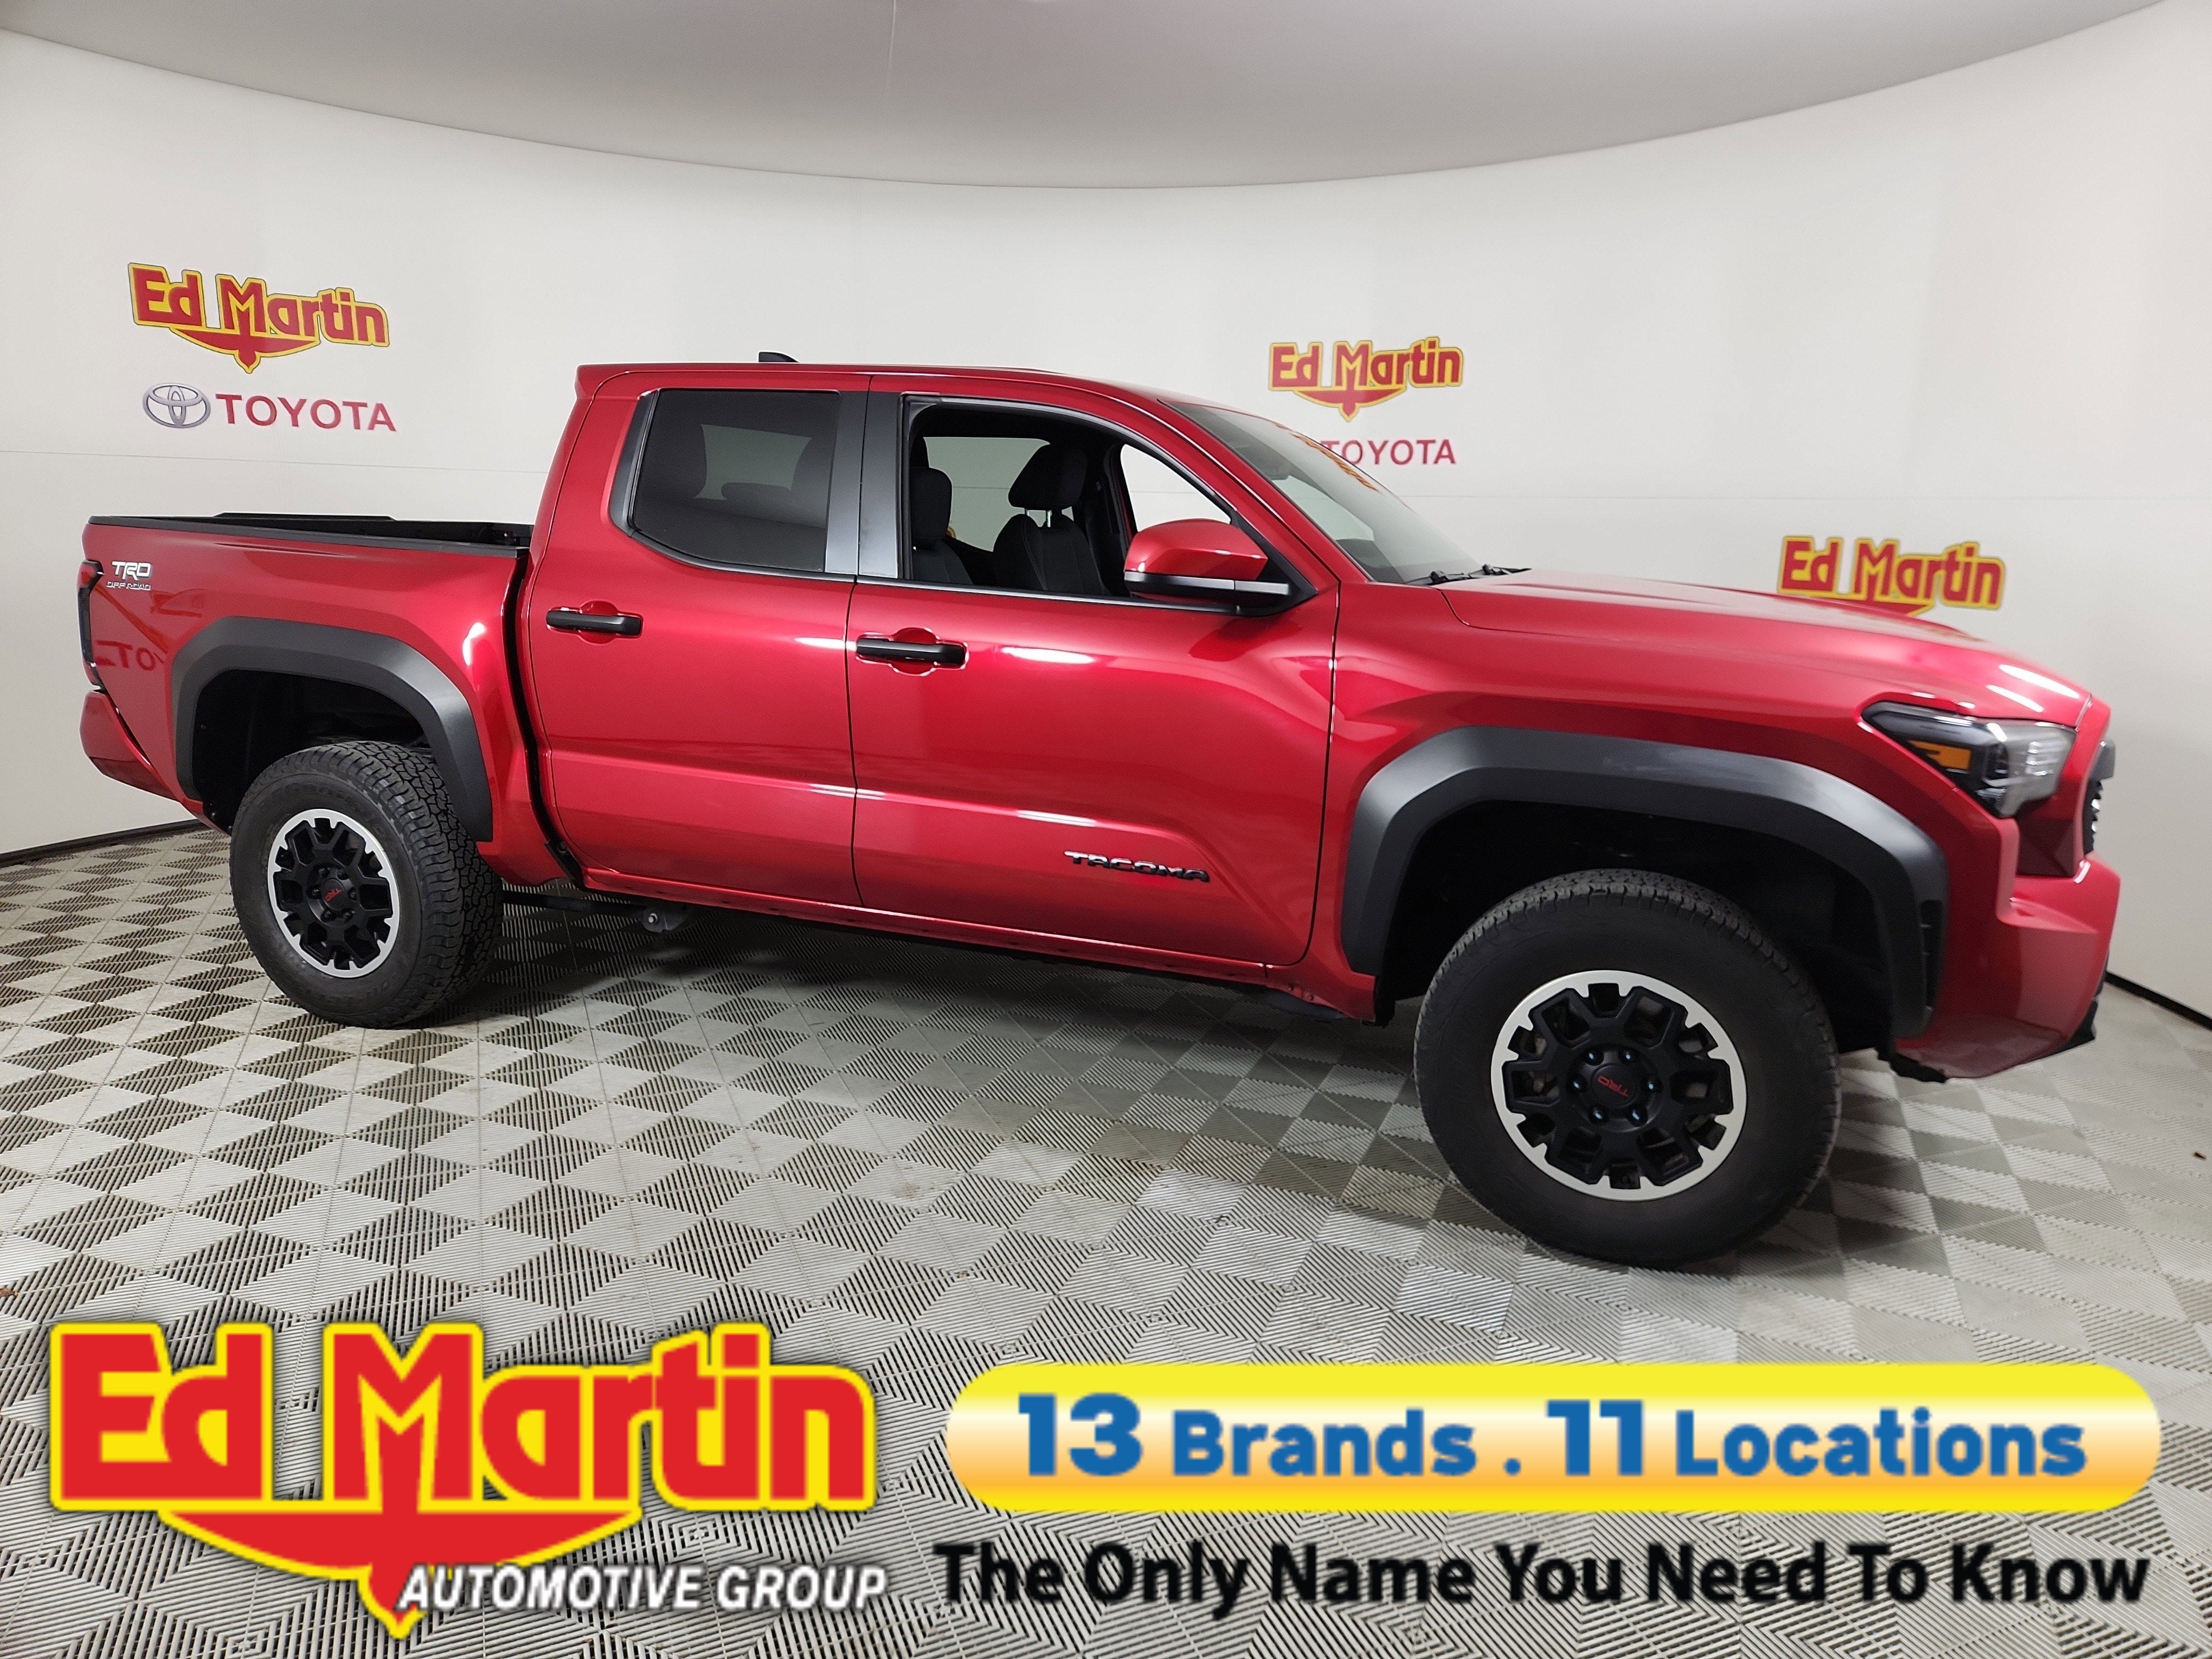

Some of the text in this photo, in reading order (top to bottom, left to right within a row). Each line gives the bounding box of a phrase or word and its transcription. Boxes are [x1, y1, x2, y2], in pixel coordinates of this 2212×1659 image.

[129, 263, 389, 347] Ed Martin
[1270, 337, 1463, 391] Ed Martin
[215, 393, 397, 432] TOYOTA
[112, 561, 152, 581] TRD
[1778, 536, 2004, 609] Ed Martin
[1064, 850, 1210, 883] TACOMA
